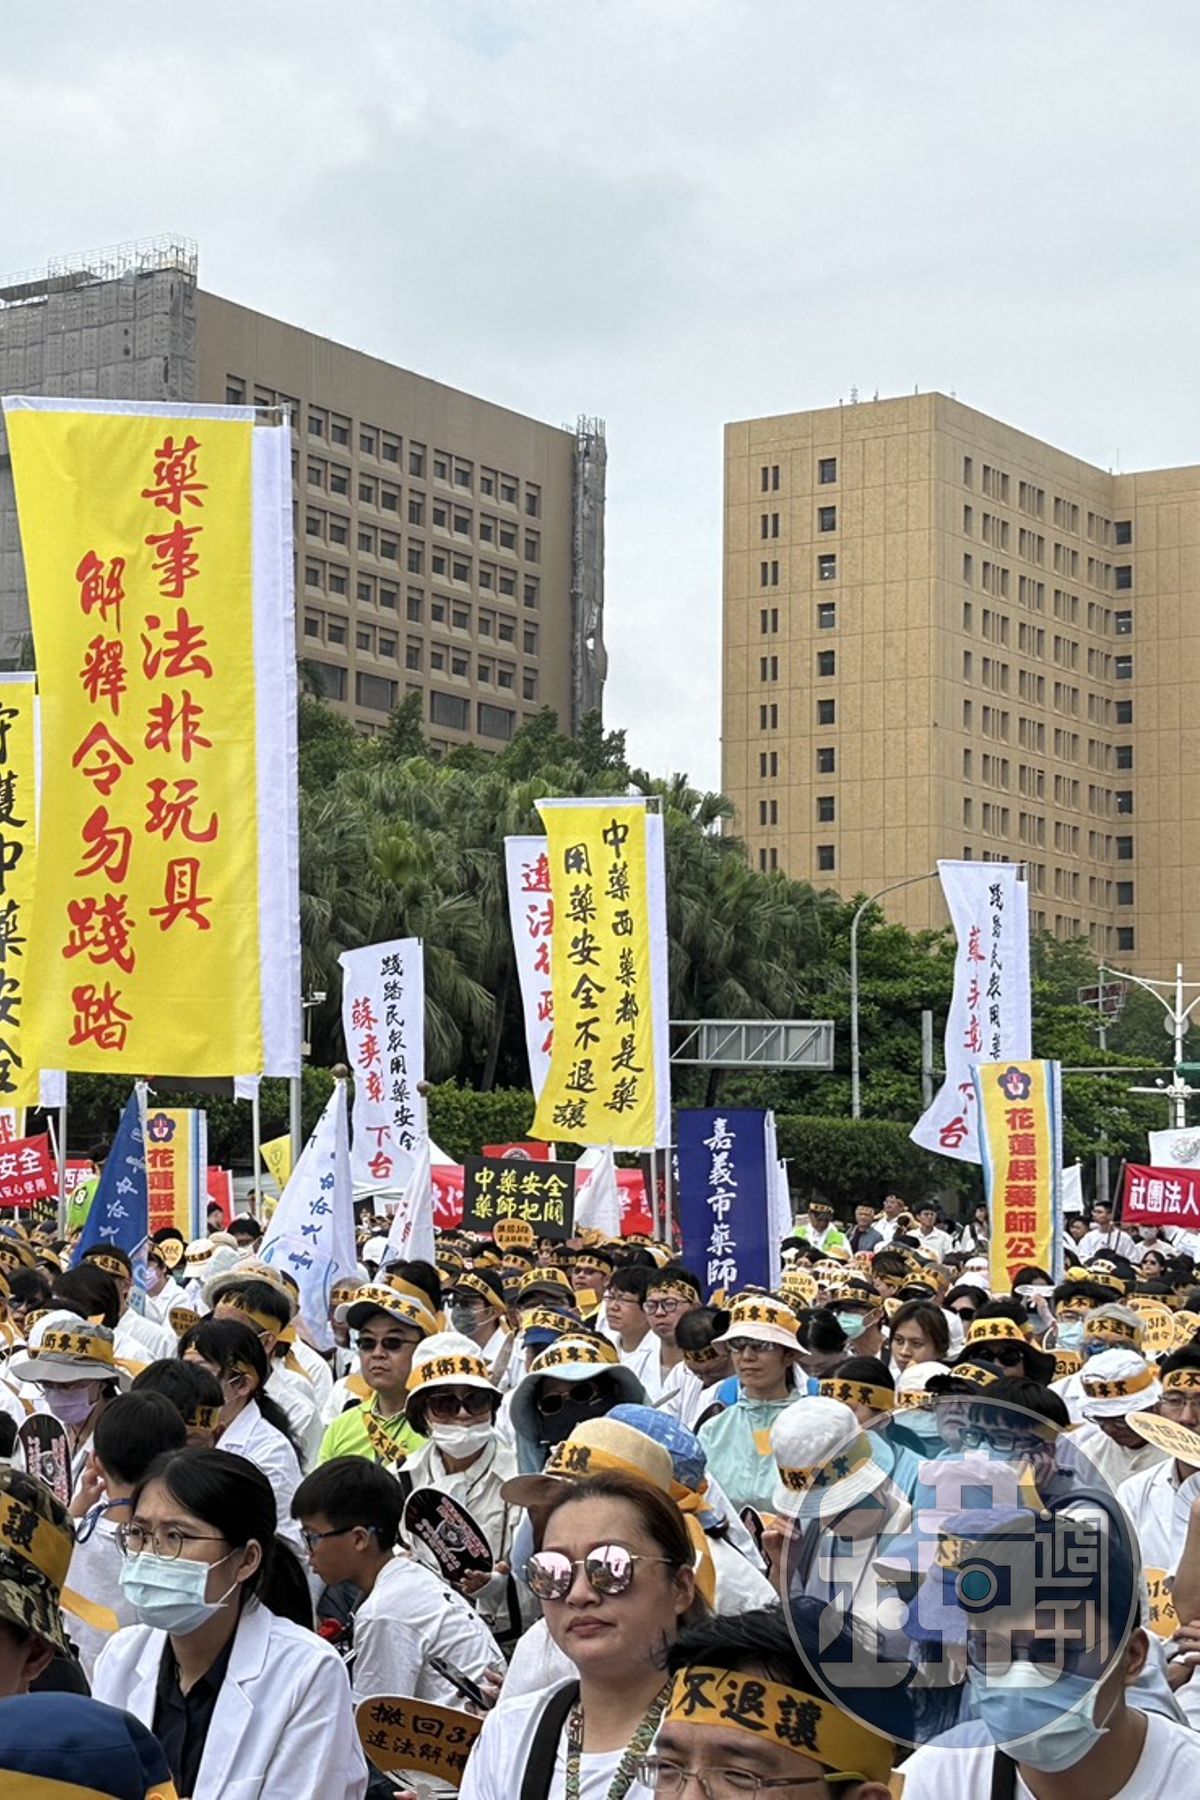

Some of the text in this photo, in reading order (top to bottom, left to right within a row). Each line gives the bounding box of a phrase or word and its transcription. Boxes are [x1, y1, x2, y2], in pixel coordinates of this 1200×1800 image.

[140, 434, 218, 931] 藥事法非玩具
[61, 549, 136, 1053] 解釋令勿踐踏
[552, 843, 606, 1130] 用藥安全不退讓
[602, 818, 644, 1114] 中藥西藥都是藥
[365, 1124, 394, 1180] 下台
[471, 1194, 565, 1225] 藥師把關
[474, 1166, 569, 1198] 中藥安全
[703, 1117, 738, 1291] 嘉義市藥師
[1129, 1177, 1199, 1216] 社團法人
